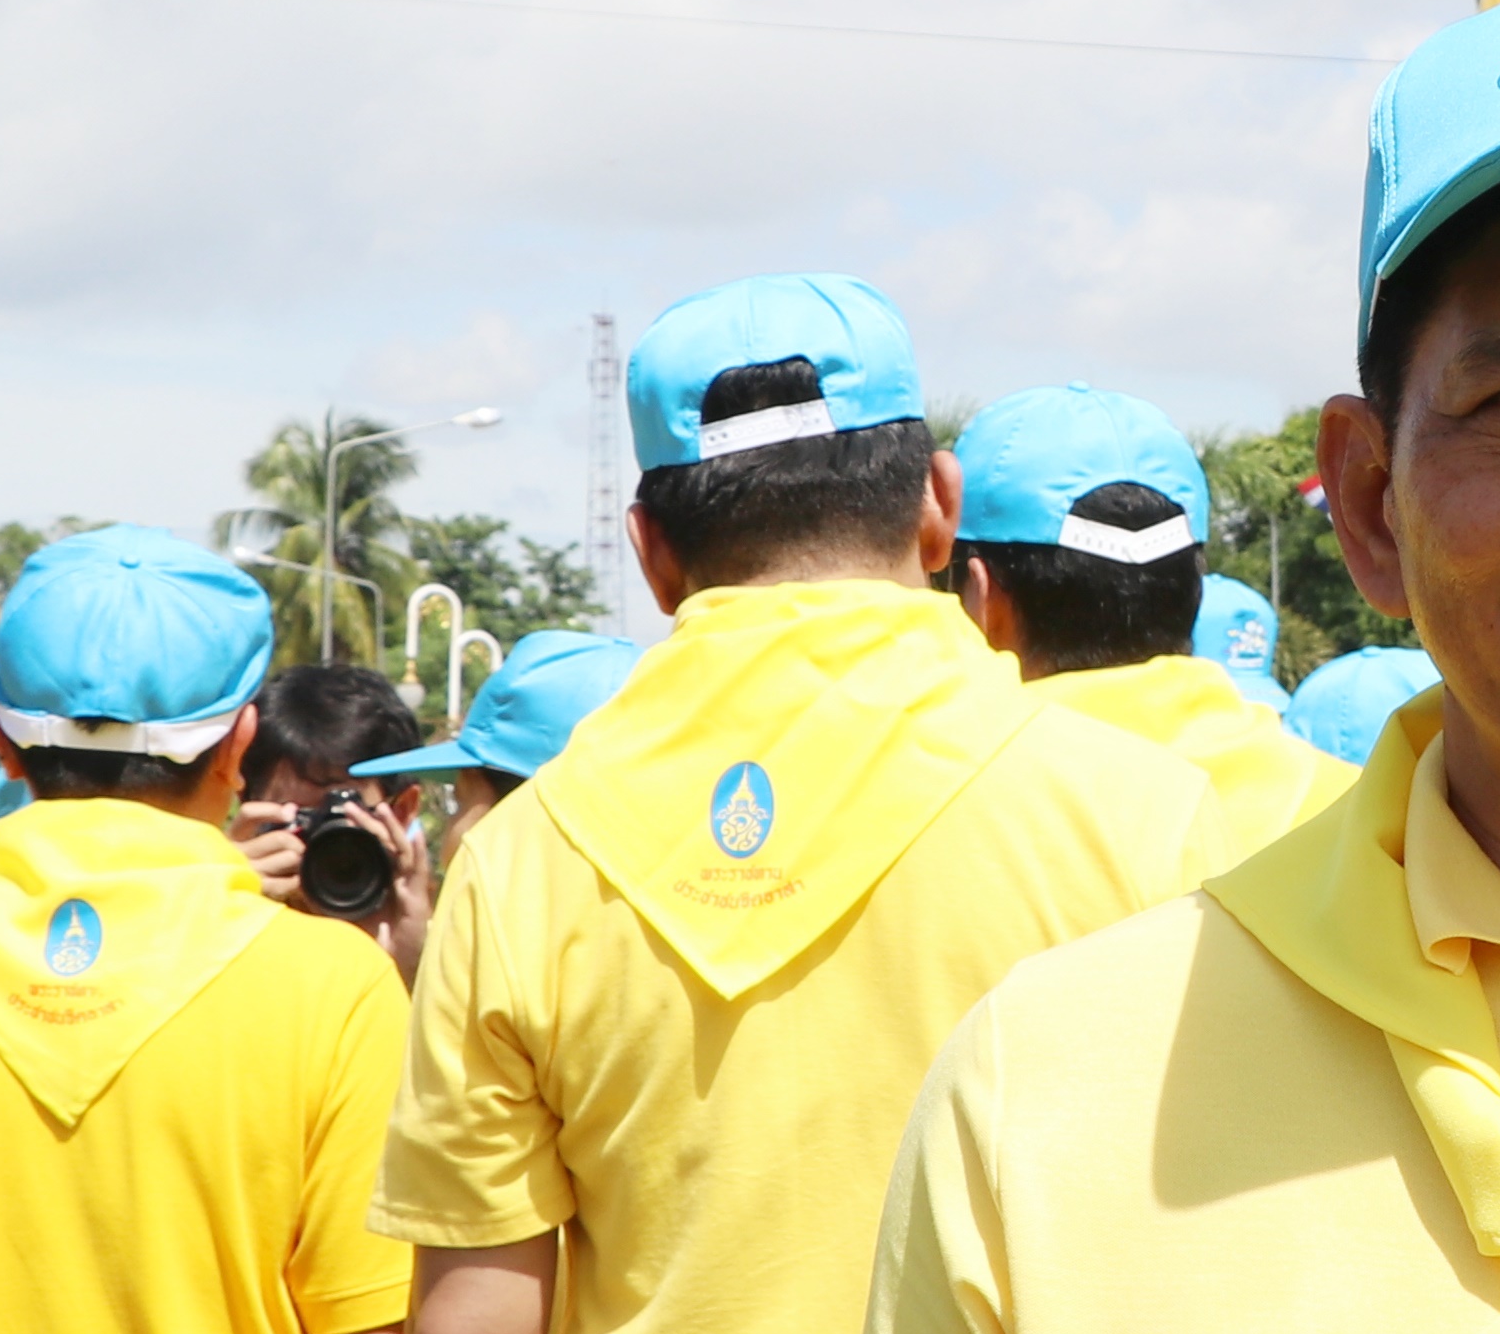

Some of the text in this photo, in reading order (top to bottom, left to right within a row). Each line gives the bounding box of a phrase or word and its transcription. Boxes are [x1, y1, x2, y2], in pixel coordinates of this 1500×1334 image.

[701, 865, 782, 880] พระราชทาน
[672, 879, 806, 909] ประชาชนจิตอาสา
